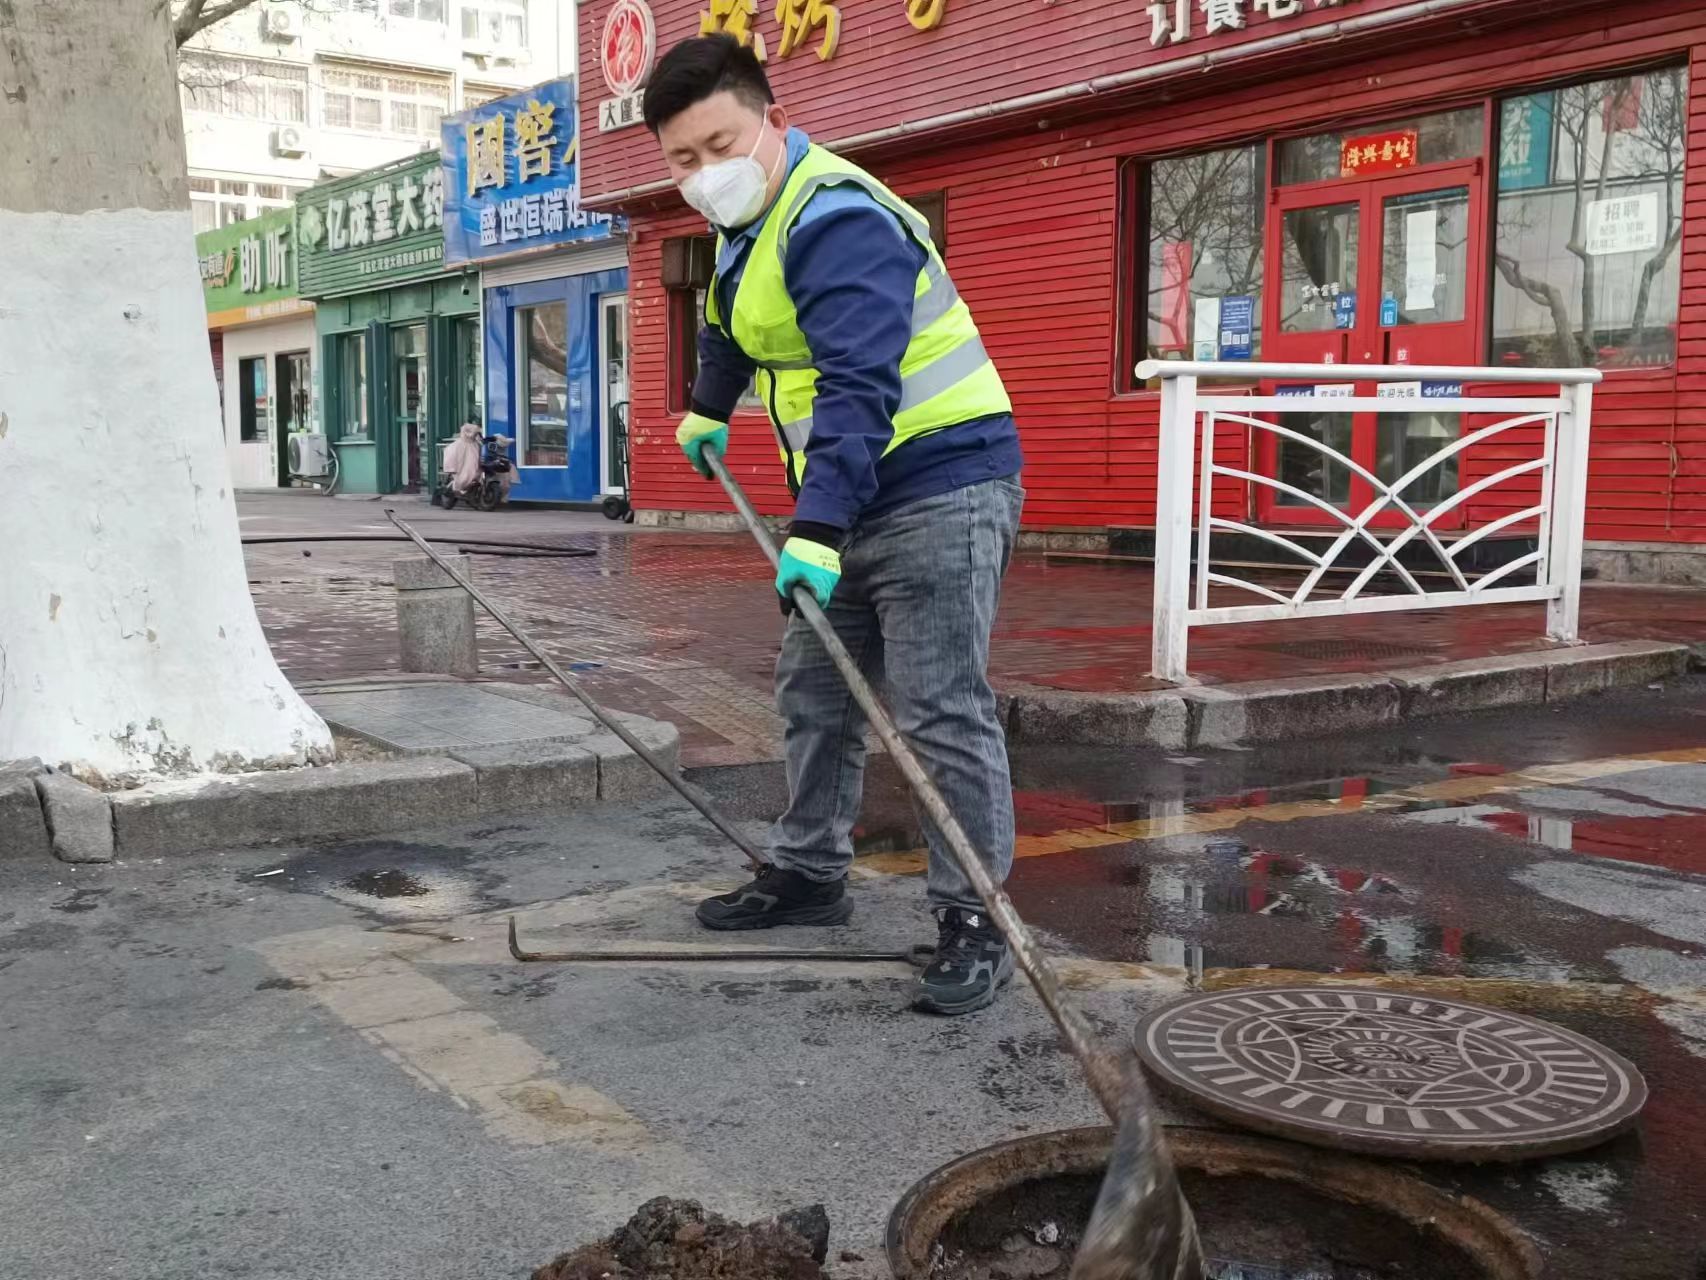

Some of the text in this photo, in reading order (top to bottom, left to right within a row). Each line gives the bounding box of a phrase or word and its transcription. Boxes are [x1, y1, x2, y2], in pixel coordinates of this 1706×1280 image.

[466, 98, 577, 198] 國窖
[1604, 200, 1641, 222] 招聘
[240, 227, 289, 292] 助听
[1341, 296, 1352, 308] 拉
[1378, 386, 1415, 398] 欢迎光临
